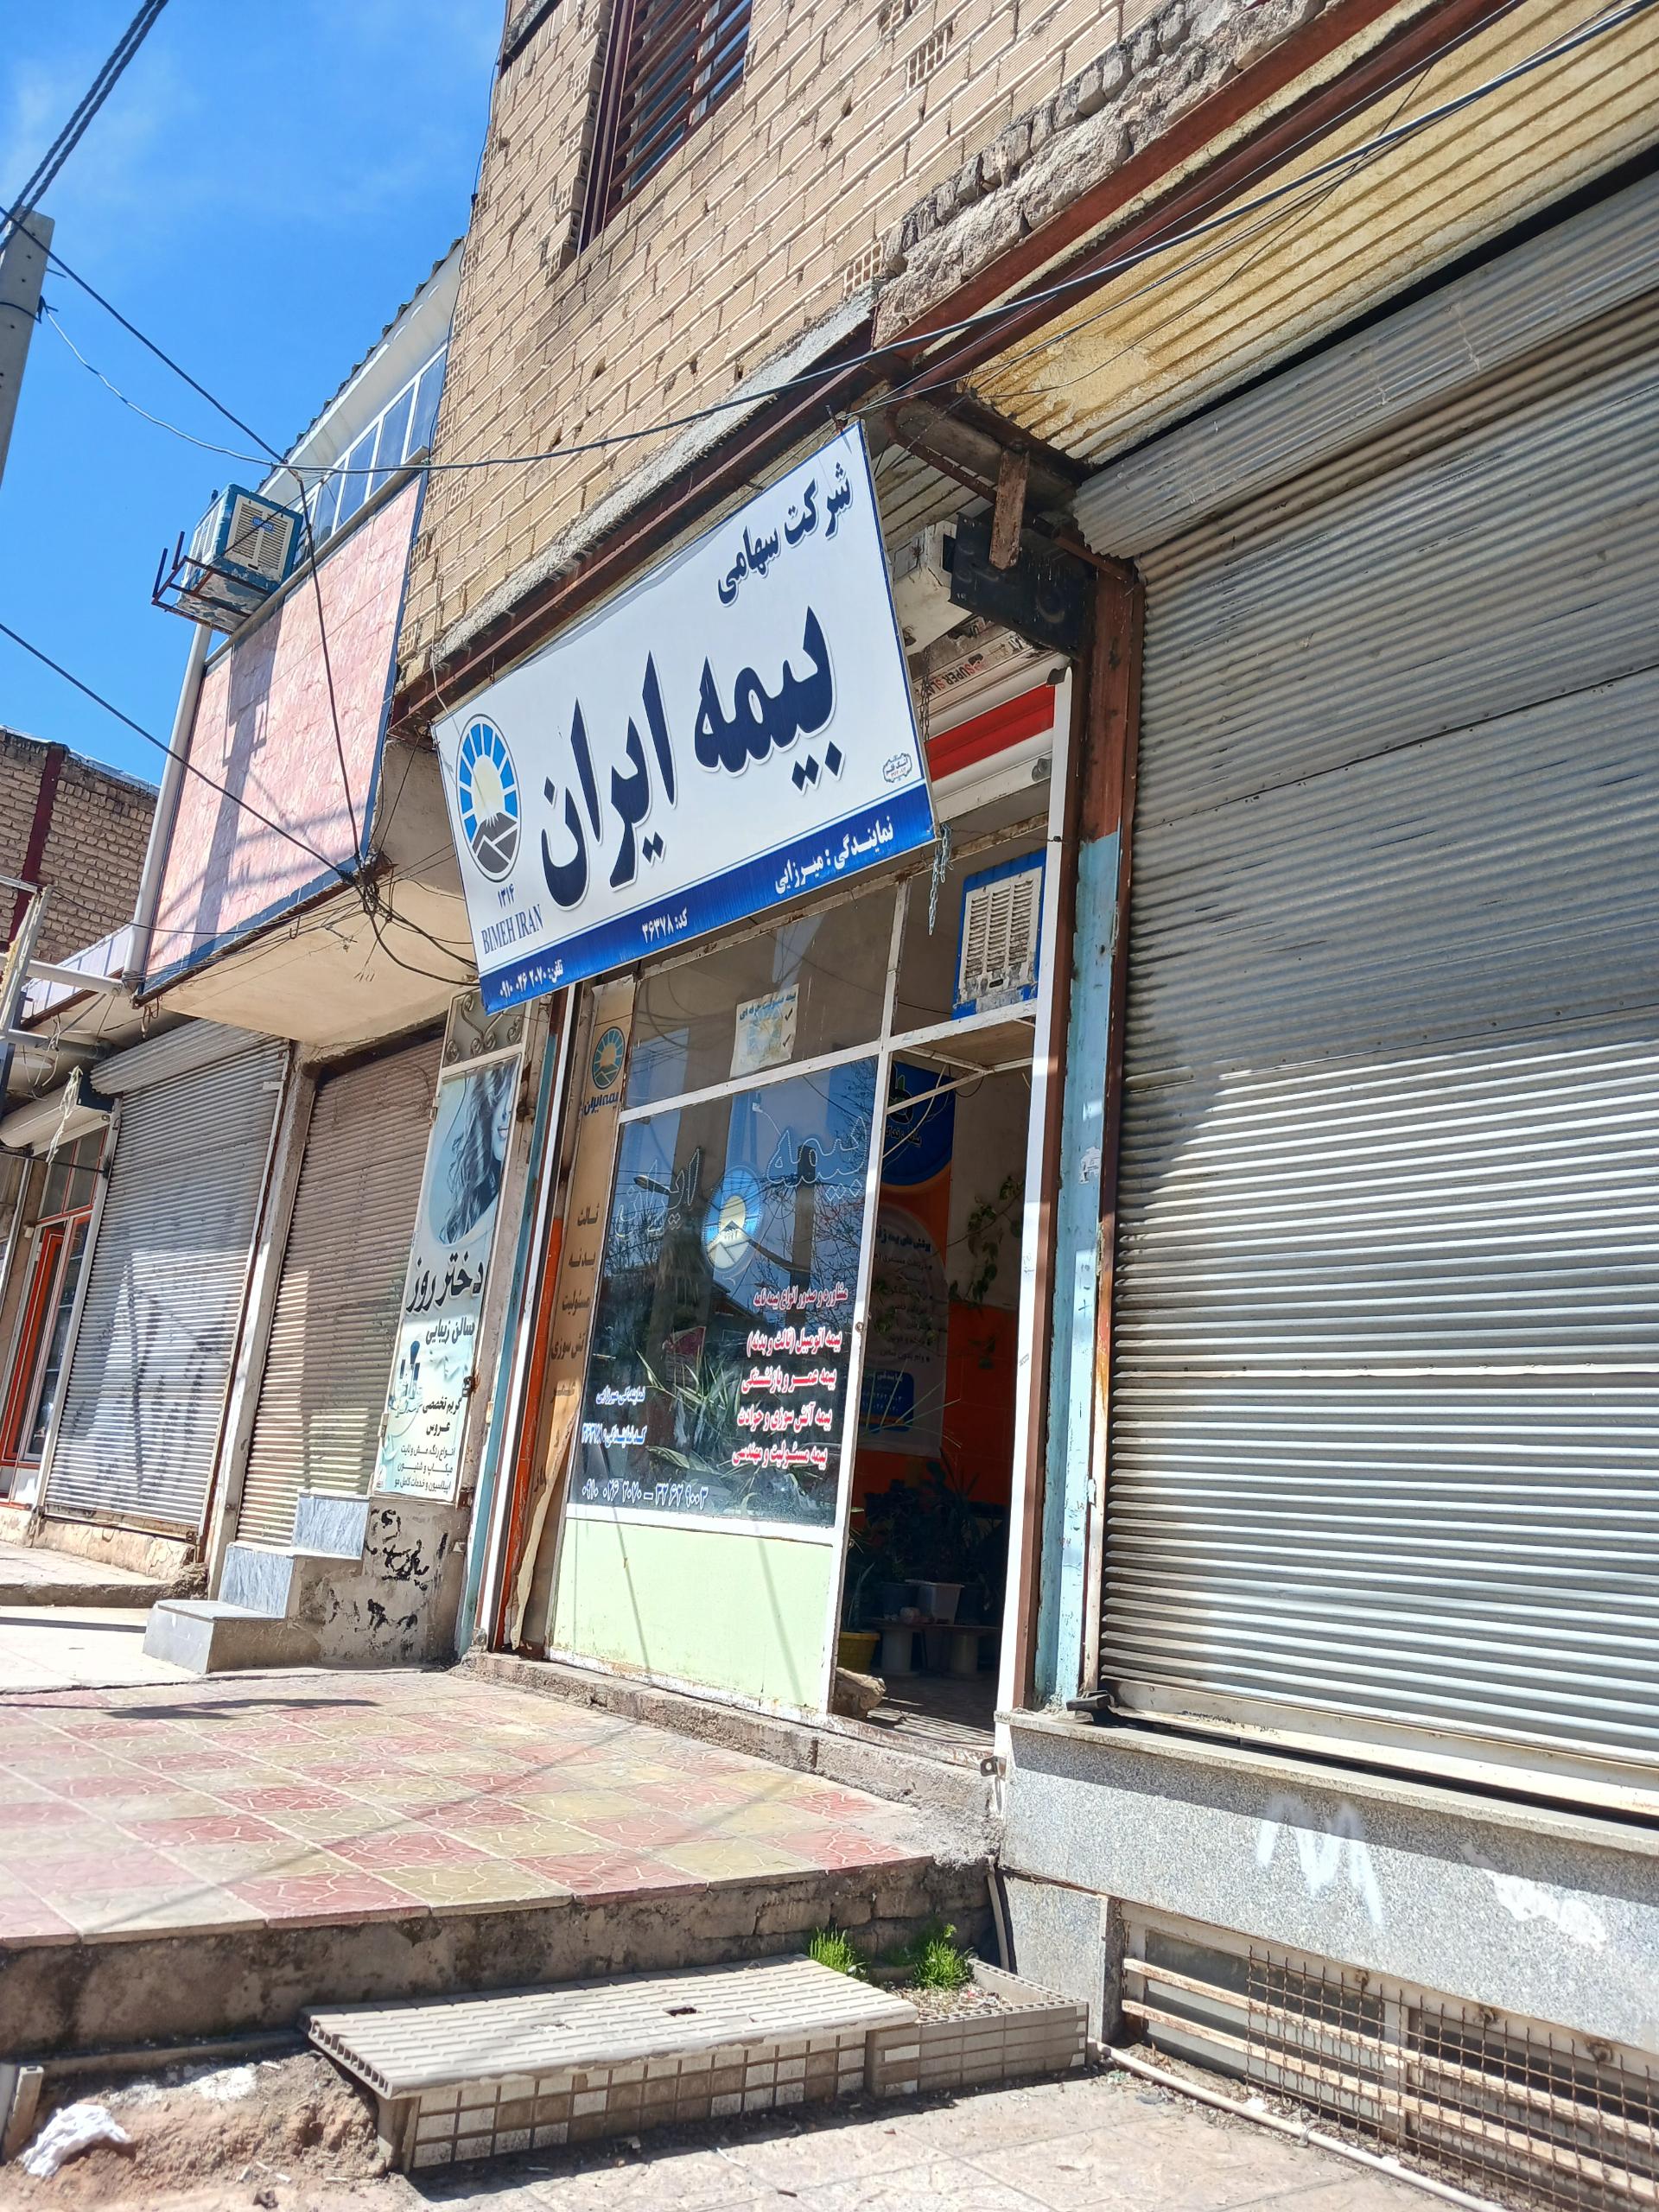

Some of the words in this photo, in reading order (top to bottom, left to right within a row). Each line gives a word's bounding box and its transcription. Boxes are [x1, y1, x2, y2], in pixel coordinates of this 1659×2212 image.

[785, 461, 852, 545] شرکت
[718, 525, 779, 605] سهامی
[695, 606, 843, 791] بیمه
[542, 651, 675, 906] ایران
[834, 816, 893, 870] نمایندگی
[775, 855, 823, 894] میرزایی
[498, 883, 514, 908] ۱۳۱۴
[481, 917, 516, 955] BIMEH
[515, 904, 543, 939] IRAN
[642, 913, 674, 944] ۳۶۳۷۸
[405, 1256, 437, 1313] روز
[435, 1250, 484, 1307] دختر
[779, 1284, 798, 1310] انواع
[796, 1287, 817, 1309] صدور
[425, 1318, 451, 1345] زیبایی
[451, 1316, 476, 1344] سالن
[795, 1326, 826, 1355] اتومبیل
[824, 1329, 842, 1353] بیمه
[741, 1365, 783, 1394] بازنشستگی
[781, 1373, 789, 1393] و
[788, 1369, 819, 1393] عمر
[818, 1367, 837, 1390] بیمه
[426, 1421, 450, 1437] عروس
[737, 1403, 764, 1432] حوادث
[762, 1412, 770, 1431] و
[770, 1407, 794, 1431] سوزی
[793, 1402, 817, 1433] آتش
[815, 1408, 833, 1432] بیمه
[732, 1442, 763, 1466] مهندسی
[761, 1448, 769, 1468] و
[770, 1440, 810, 1470] مسئولیت
[810, 1445, 828, 1471] بیمه
